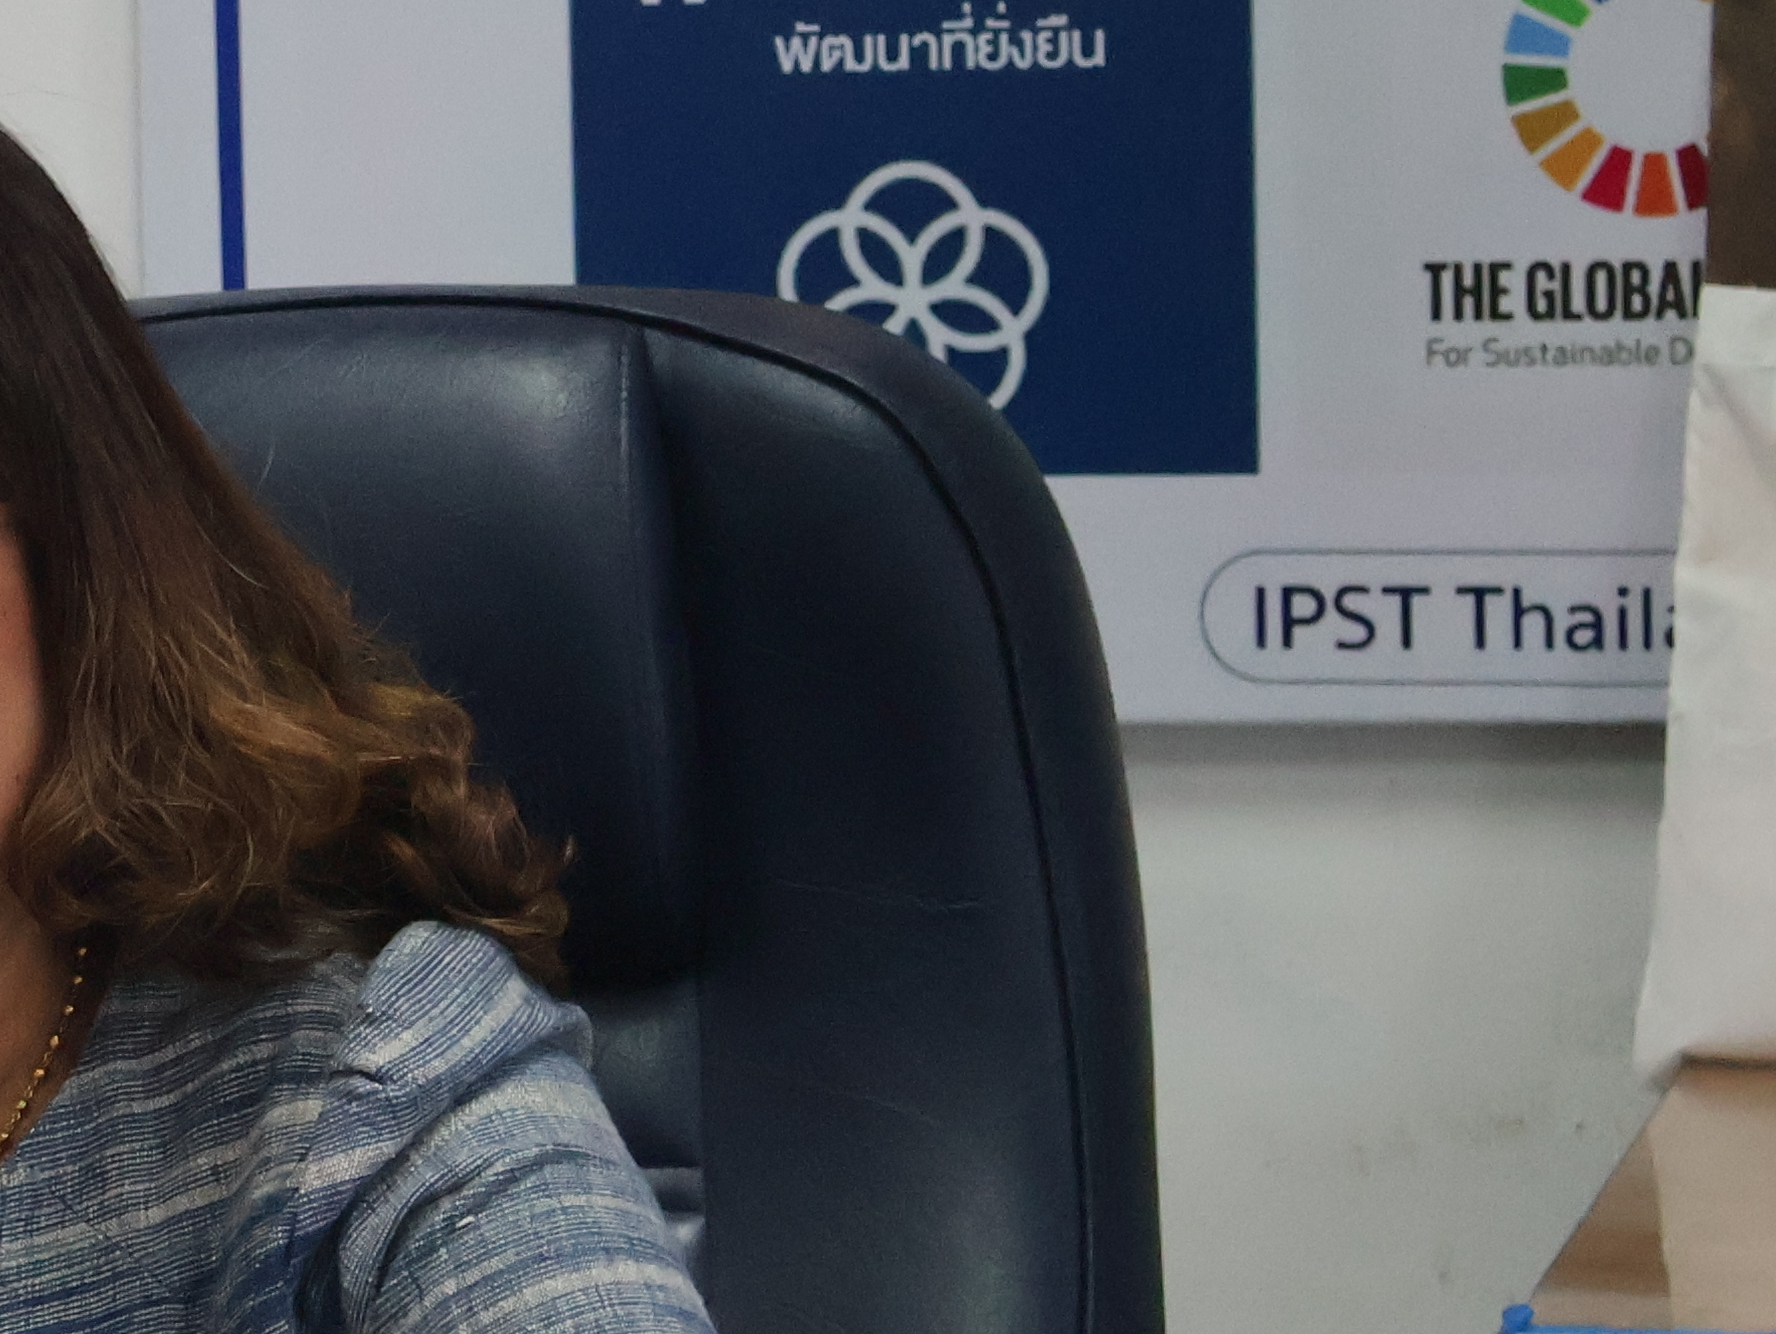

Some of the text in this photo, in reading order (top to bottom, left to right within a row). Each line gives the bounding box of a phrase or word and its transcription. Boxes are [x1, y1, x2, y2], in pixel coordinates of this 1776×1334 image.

[775, 3, 1106, 74] พัฒนาที่ยั่งยืน
[1424, 260, 1514, 321] THE
[1426, 337, 1472, 367] For
[1481, 336, 1661, 368] Sustainable
[1254, 585, 1431, 651] IPST
